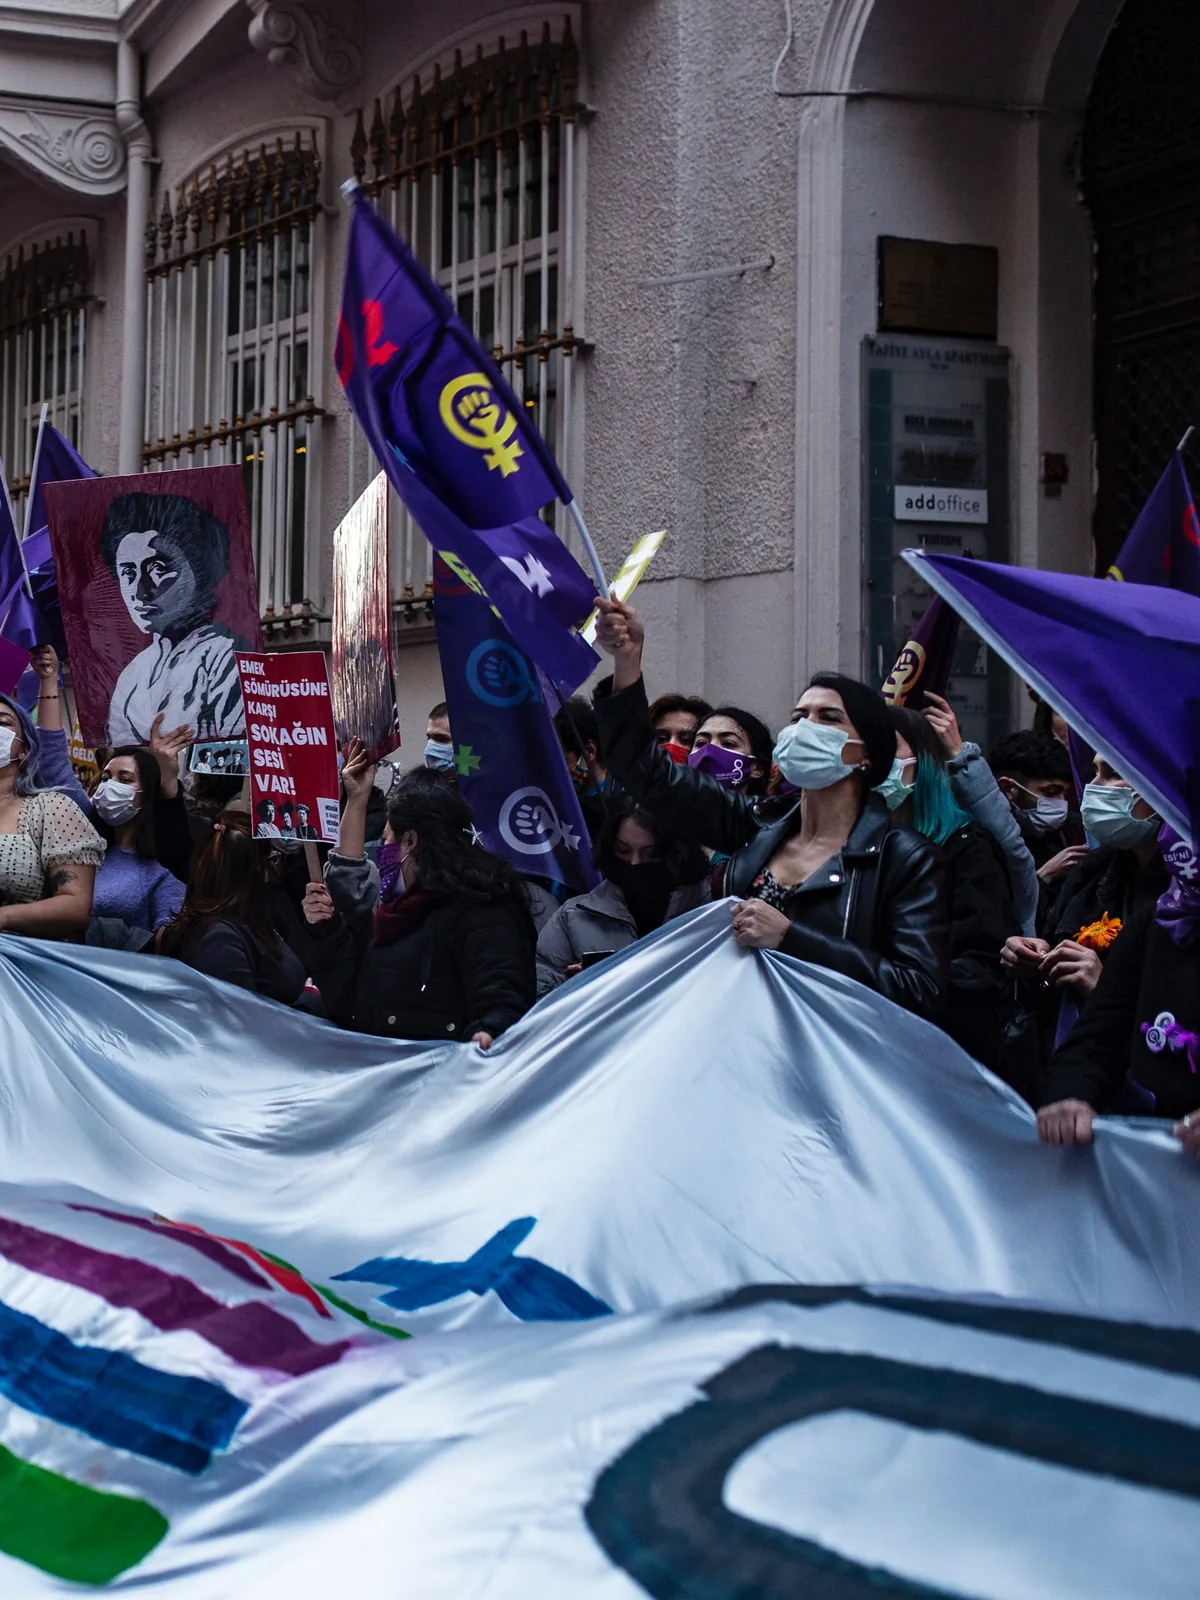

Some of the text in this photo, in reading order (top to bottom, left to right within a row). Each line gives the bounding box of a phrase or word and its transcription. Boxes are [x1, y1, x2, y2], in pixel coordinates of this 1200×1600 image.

[906, 493, 980, 512] addoffice
[240, 660, 266, 676] EMEK
[243, 677, 328, 698] SÖMÜRÜSÜNE
[247, 700, 277, 722] KARŞI
[250, 720, 328, 746] SOKAĞIN
[253, 746, 285, 770] SESİ
[254, 773, 297, 796] VAR!
